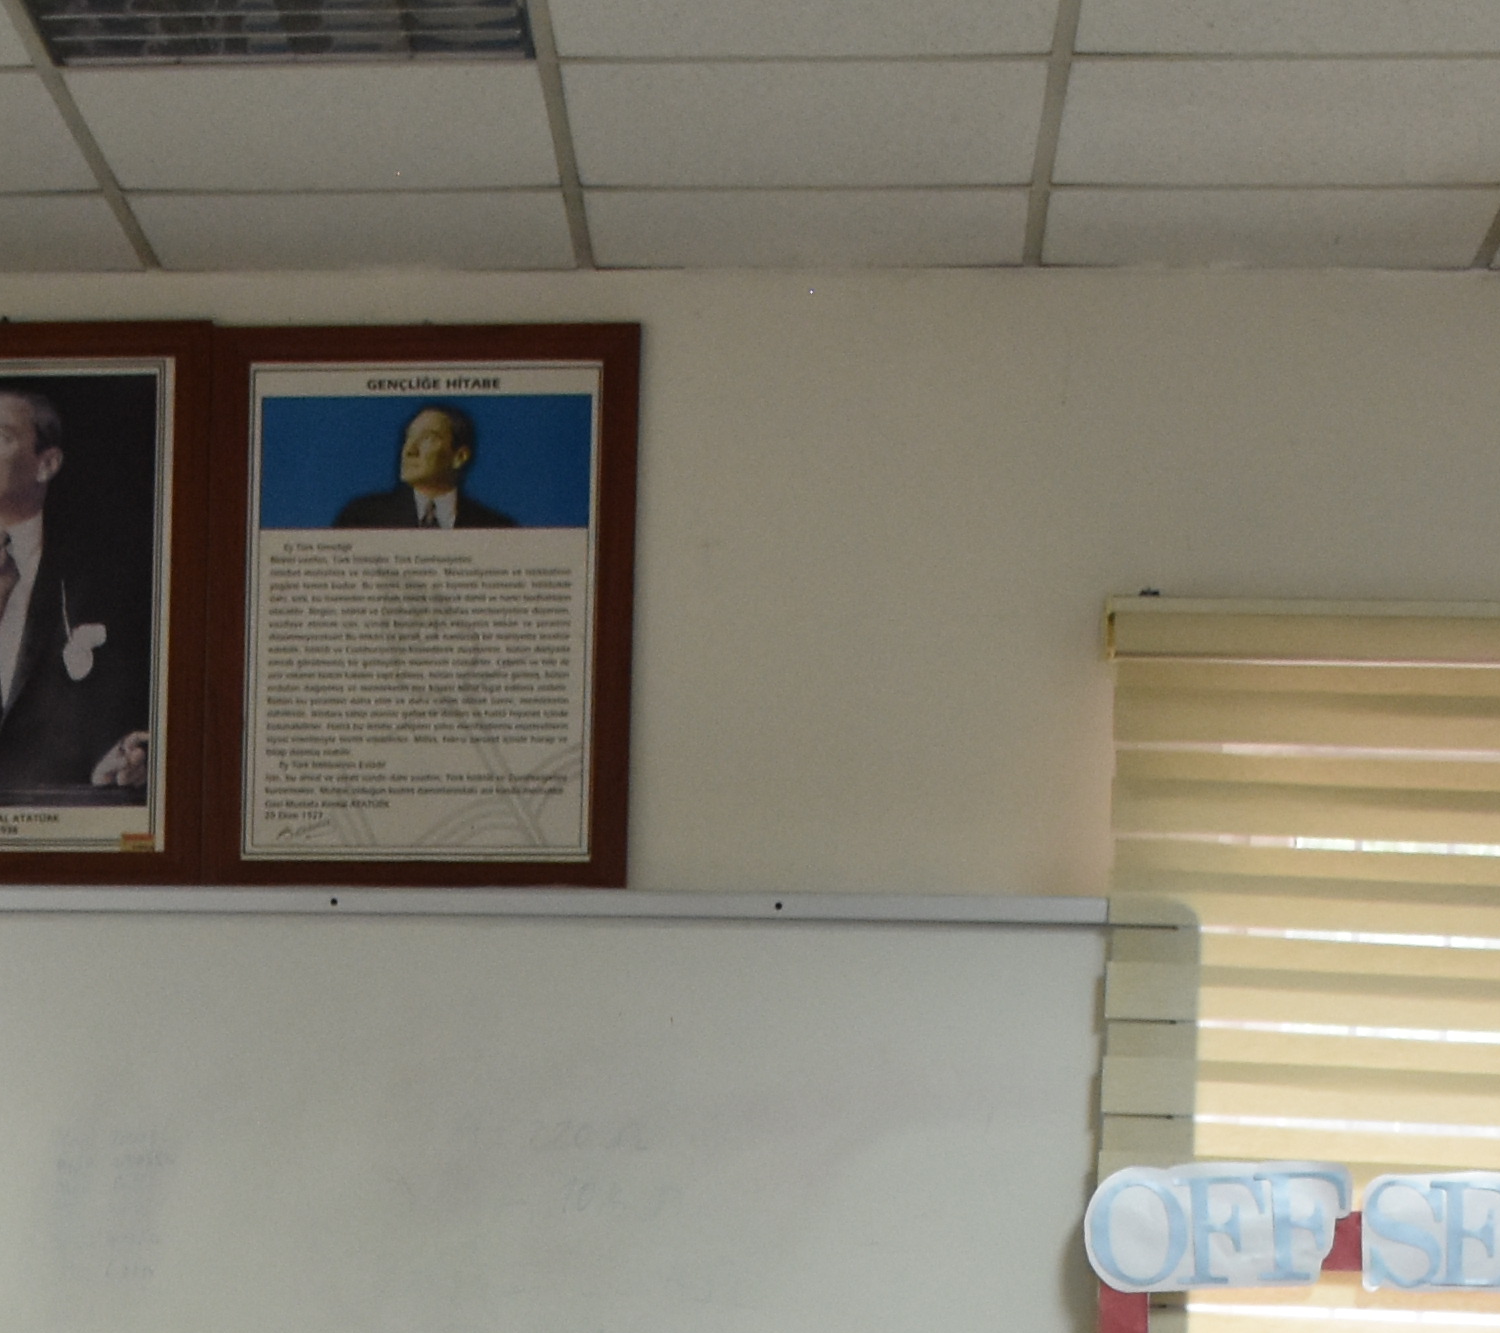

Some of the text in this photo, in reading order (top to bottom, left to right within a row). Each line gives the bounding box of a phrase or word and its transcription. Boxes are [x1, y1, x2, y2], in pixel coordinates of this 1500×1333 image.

[366, 375, 500, 391] GENÇLİĞE HİTABE
[12, 812, 60, 823] ATATÜRK
[1090, 1166, 1349, 1288] OFF
